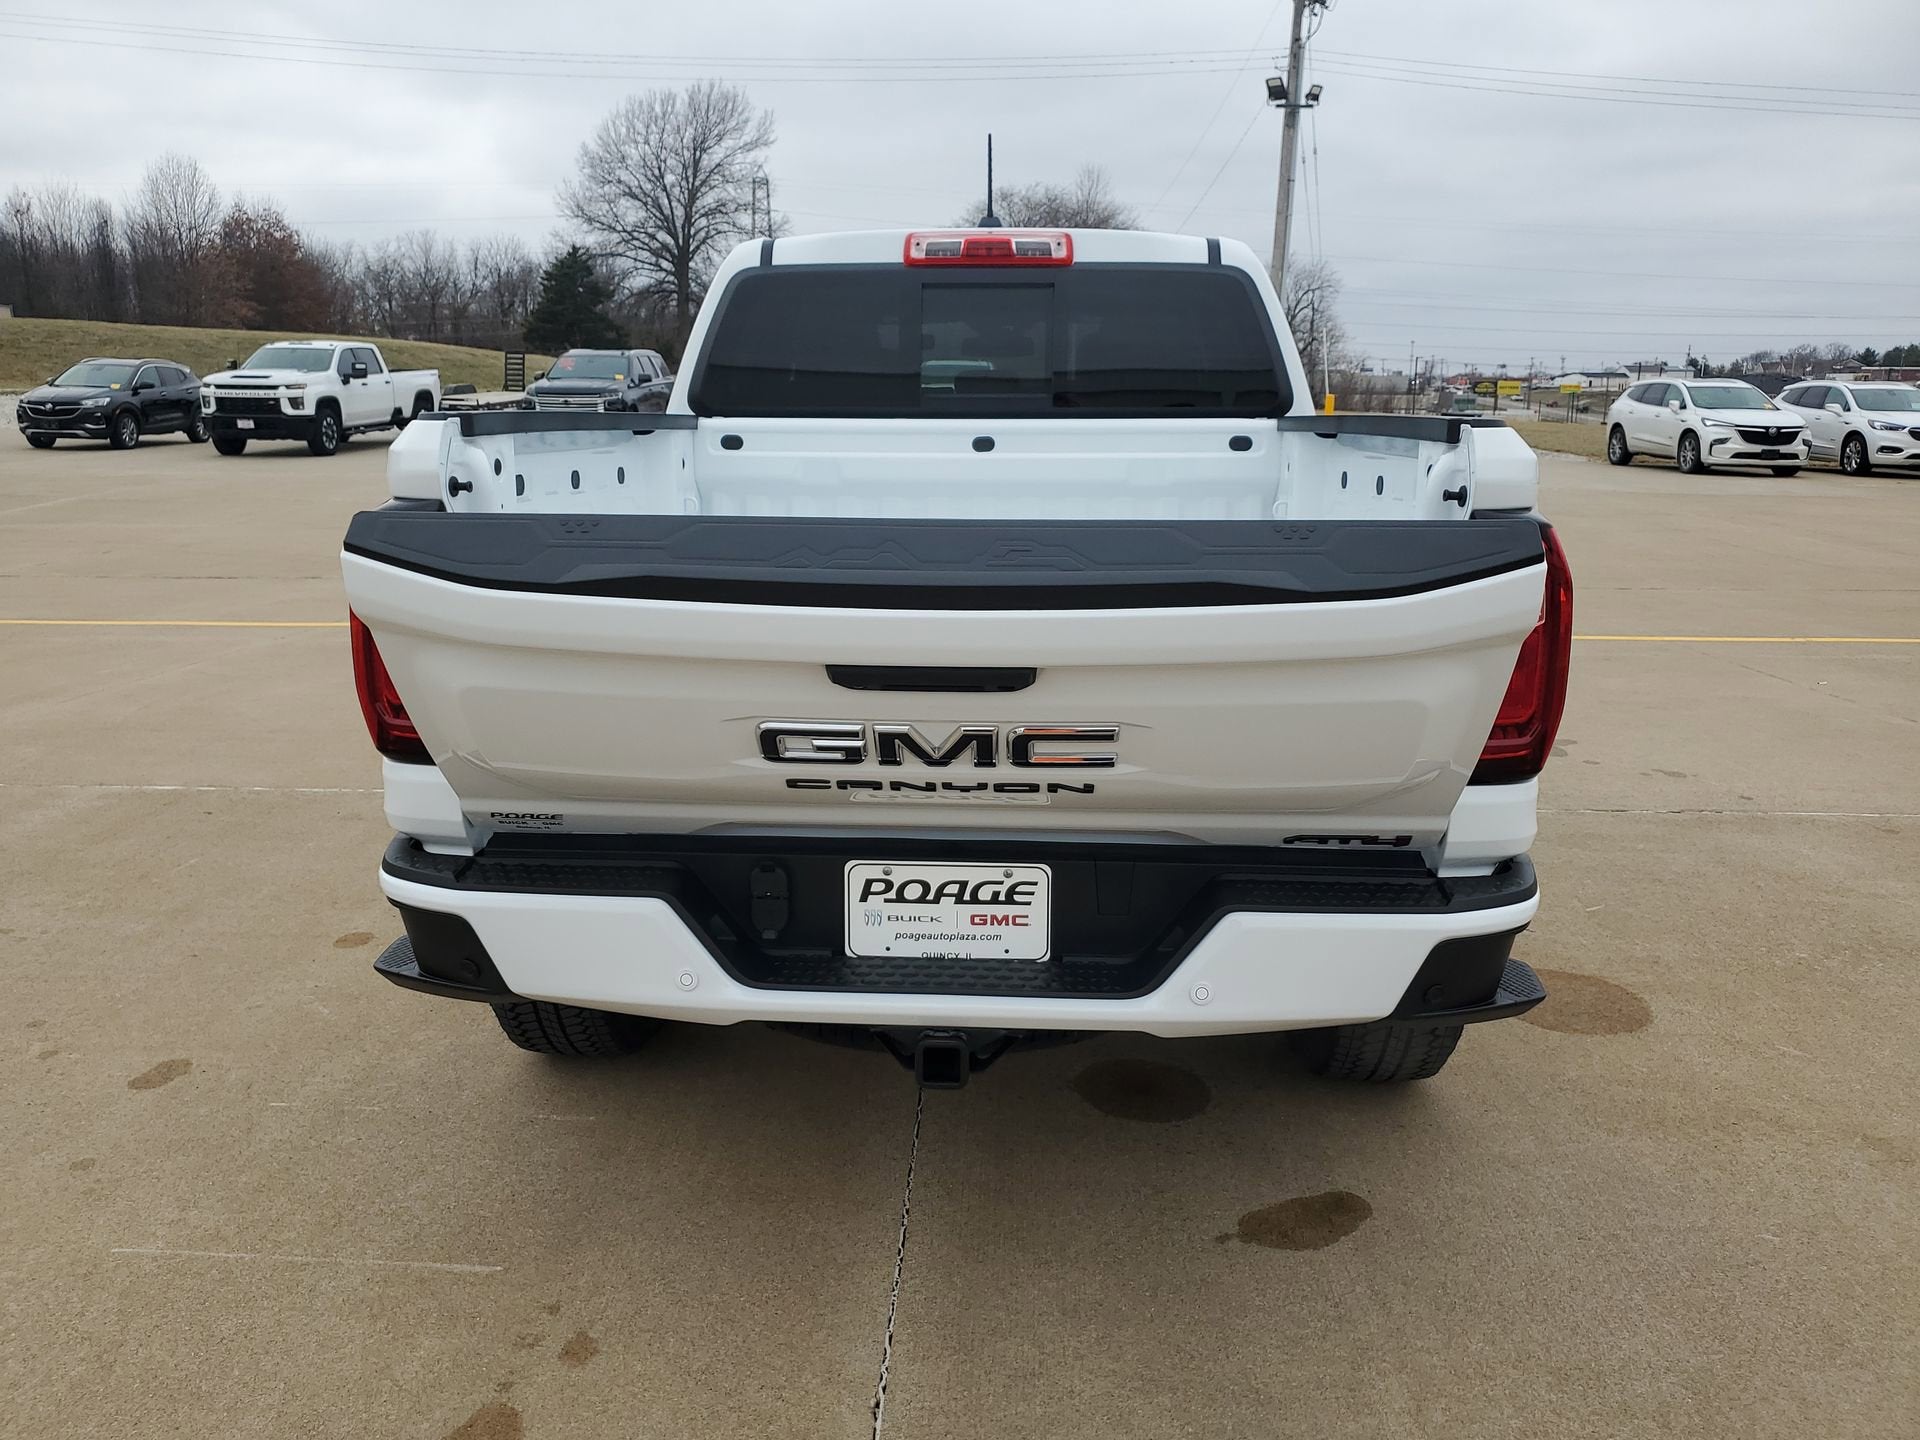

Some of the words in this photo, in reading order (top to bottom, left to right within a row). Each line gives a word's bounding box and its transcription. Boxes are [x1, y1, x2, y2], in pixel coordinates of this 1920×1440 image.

[756, 720, 1120, 767] GMC
[786, 778, 1095, 794] CANYON
[490, 812, 563, 820] POAGE
[858, 878, 1039, 906] POAGE
[887, 914, 943, 923] BUICK
[970, 914, 1030, 927] GMC
[894, 931, 1002, 942] poageautoplaza.com
[921, 951, 960, 959] QUINCY
